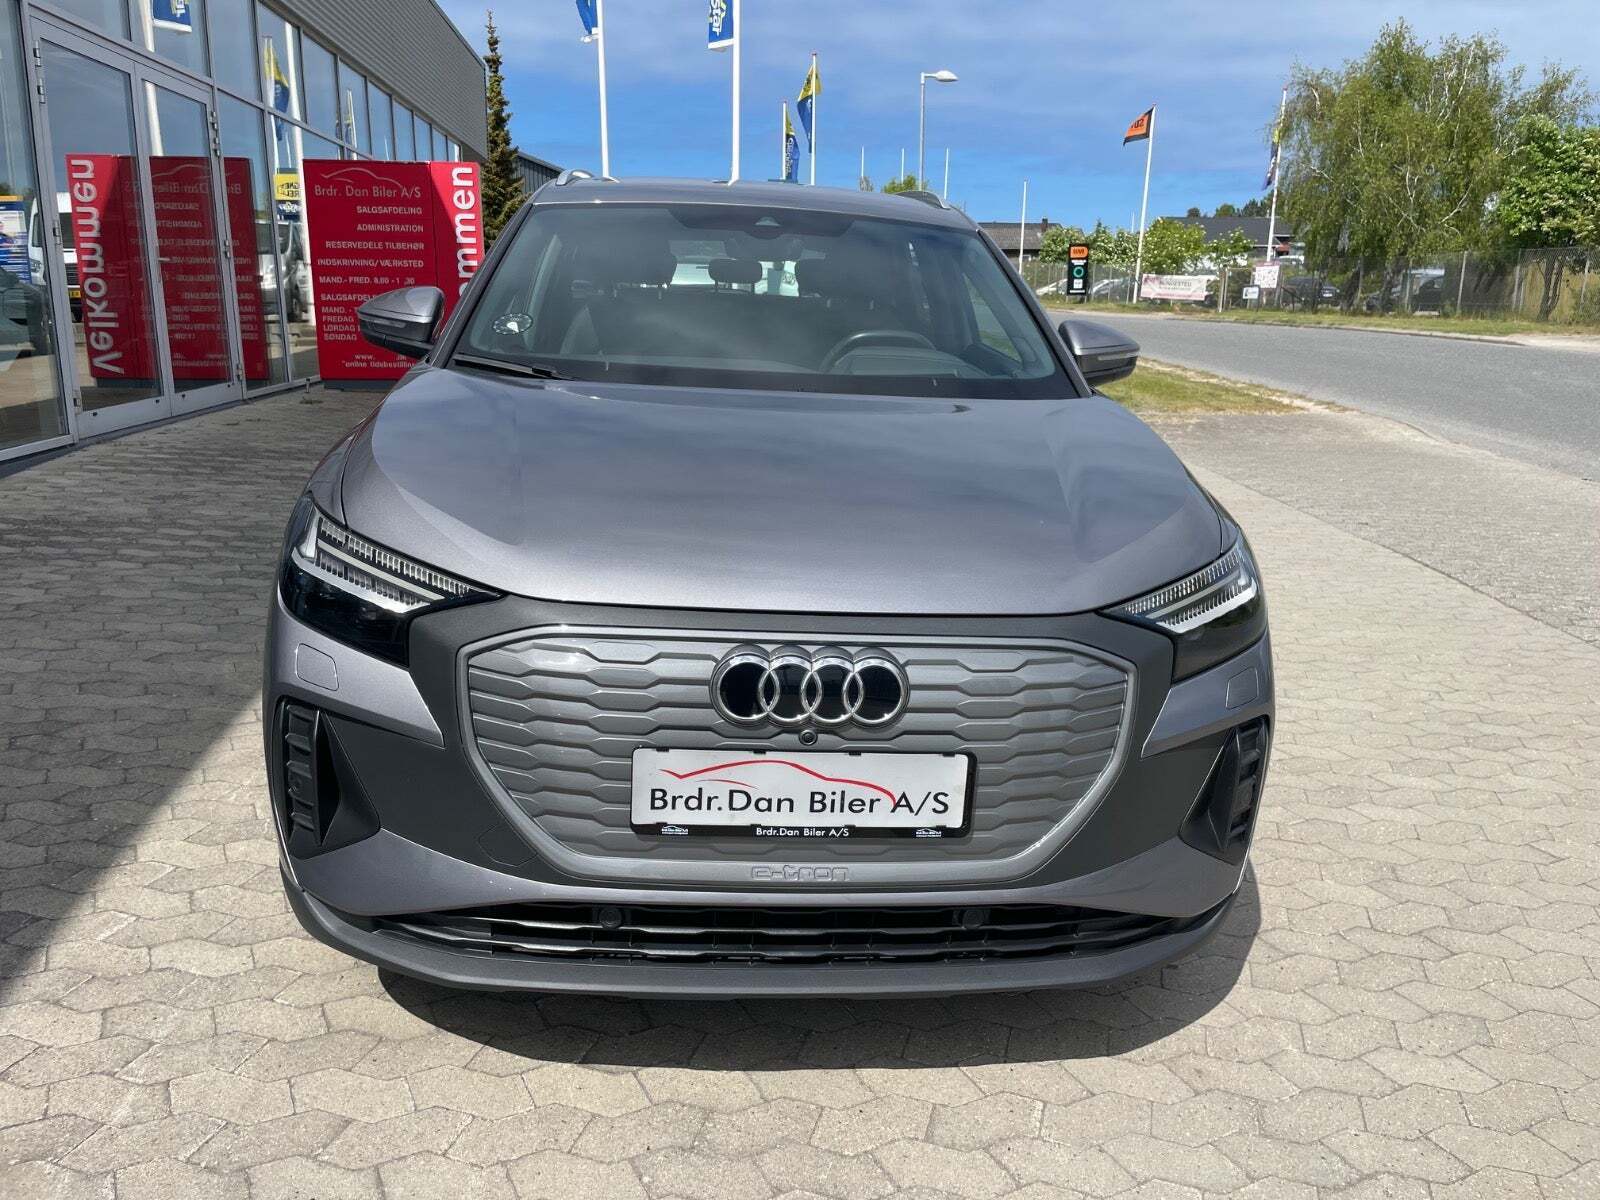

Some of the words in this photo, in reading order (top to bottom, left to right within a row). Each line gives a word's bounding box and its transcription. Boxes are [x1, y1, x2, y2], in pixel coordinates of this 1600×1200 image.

[314, 184, 341, 197] Brdr.
[346, 185, 368, 197] Dan
[373, 185, 397, 198] Biler
[401, 186, 421, 199] A/S
[356, 206, 422, 215] SALGSAFDELING
[356, 223, 424, 233] ADMINISTRATION
[325, 241, 383, 250] RESERVEDELE
[384, 241, 425, 250] TILBEHØR
[379, 259, 424, 268] VÆRKSTED
[348, 276, 372, 284] FRED.
[324, 333, 357, 341] SØNDAG
[809, 790, 881, 813] Biler
[890, 791, 949, 816] A/S
[803, 828, 826, 837] Biler
[829, 828, 849, 838] A/S
[751, 865, 849, 881] e-tron
